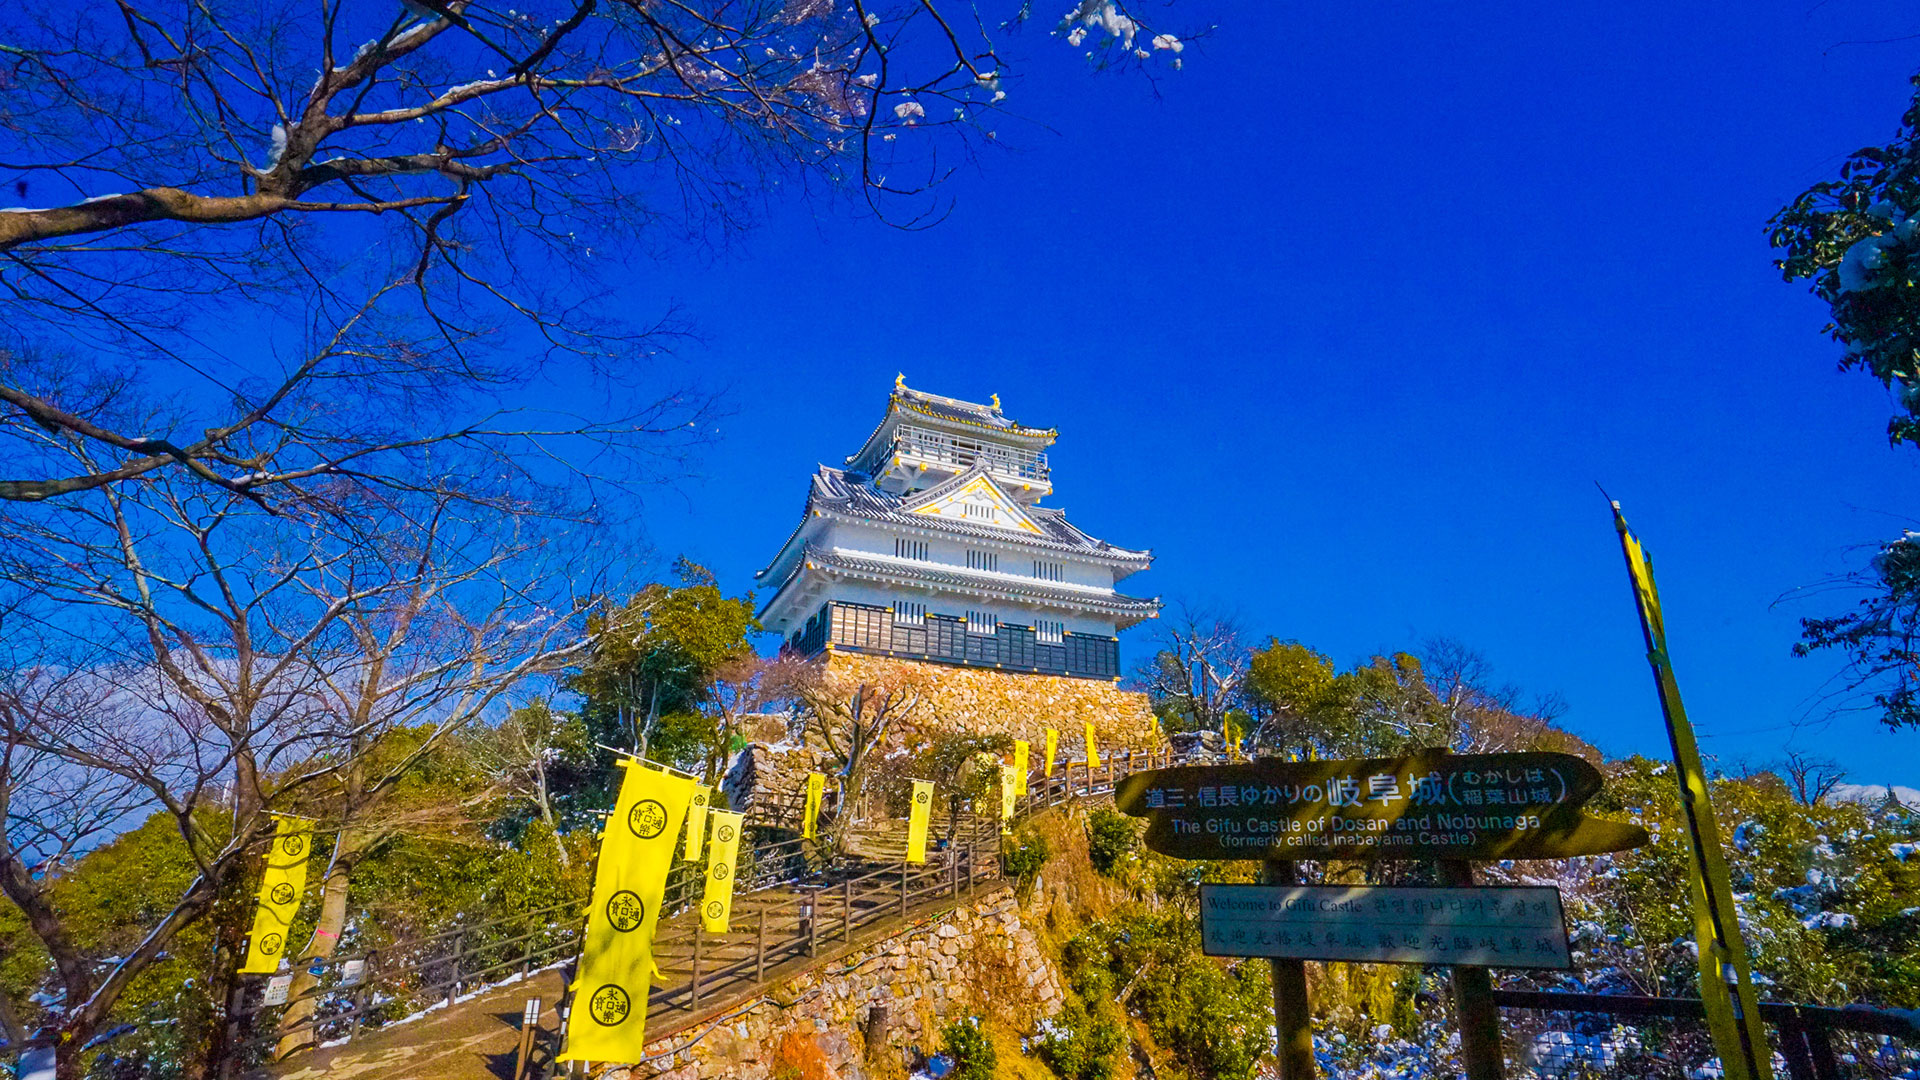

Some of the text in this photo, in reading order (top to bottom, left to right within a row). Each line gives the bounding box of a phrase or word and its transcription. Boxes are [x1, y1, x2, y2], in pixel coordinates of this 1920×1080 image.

[1171, 813, 1541, 834] The Gifu Castle of Dosan and Nobunaga
[1219, 831, 1477, 848] (formerly called Inabayama Castle)
[1207, 897, 1363, 913] Welcome to Gifu Castle
